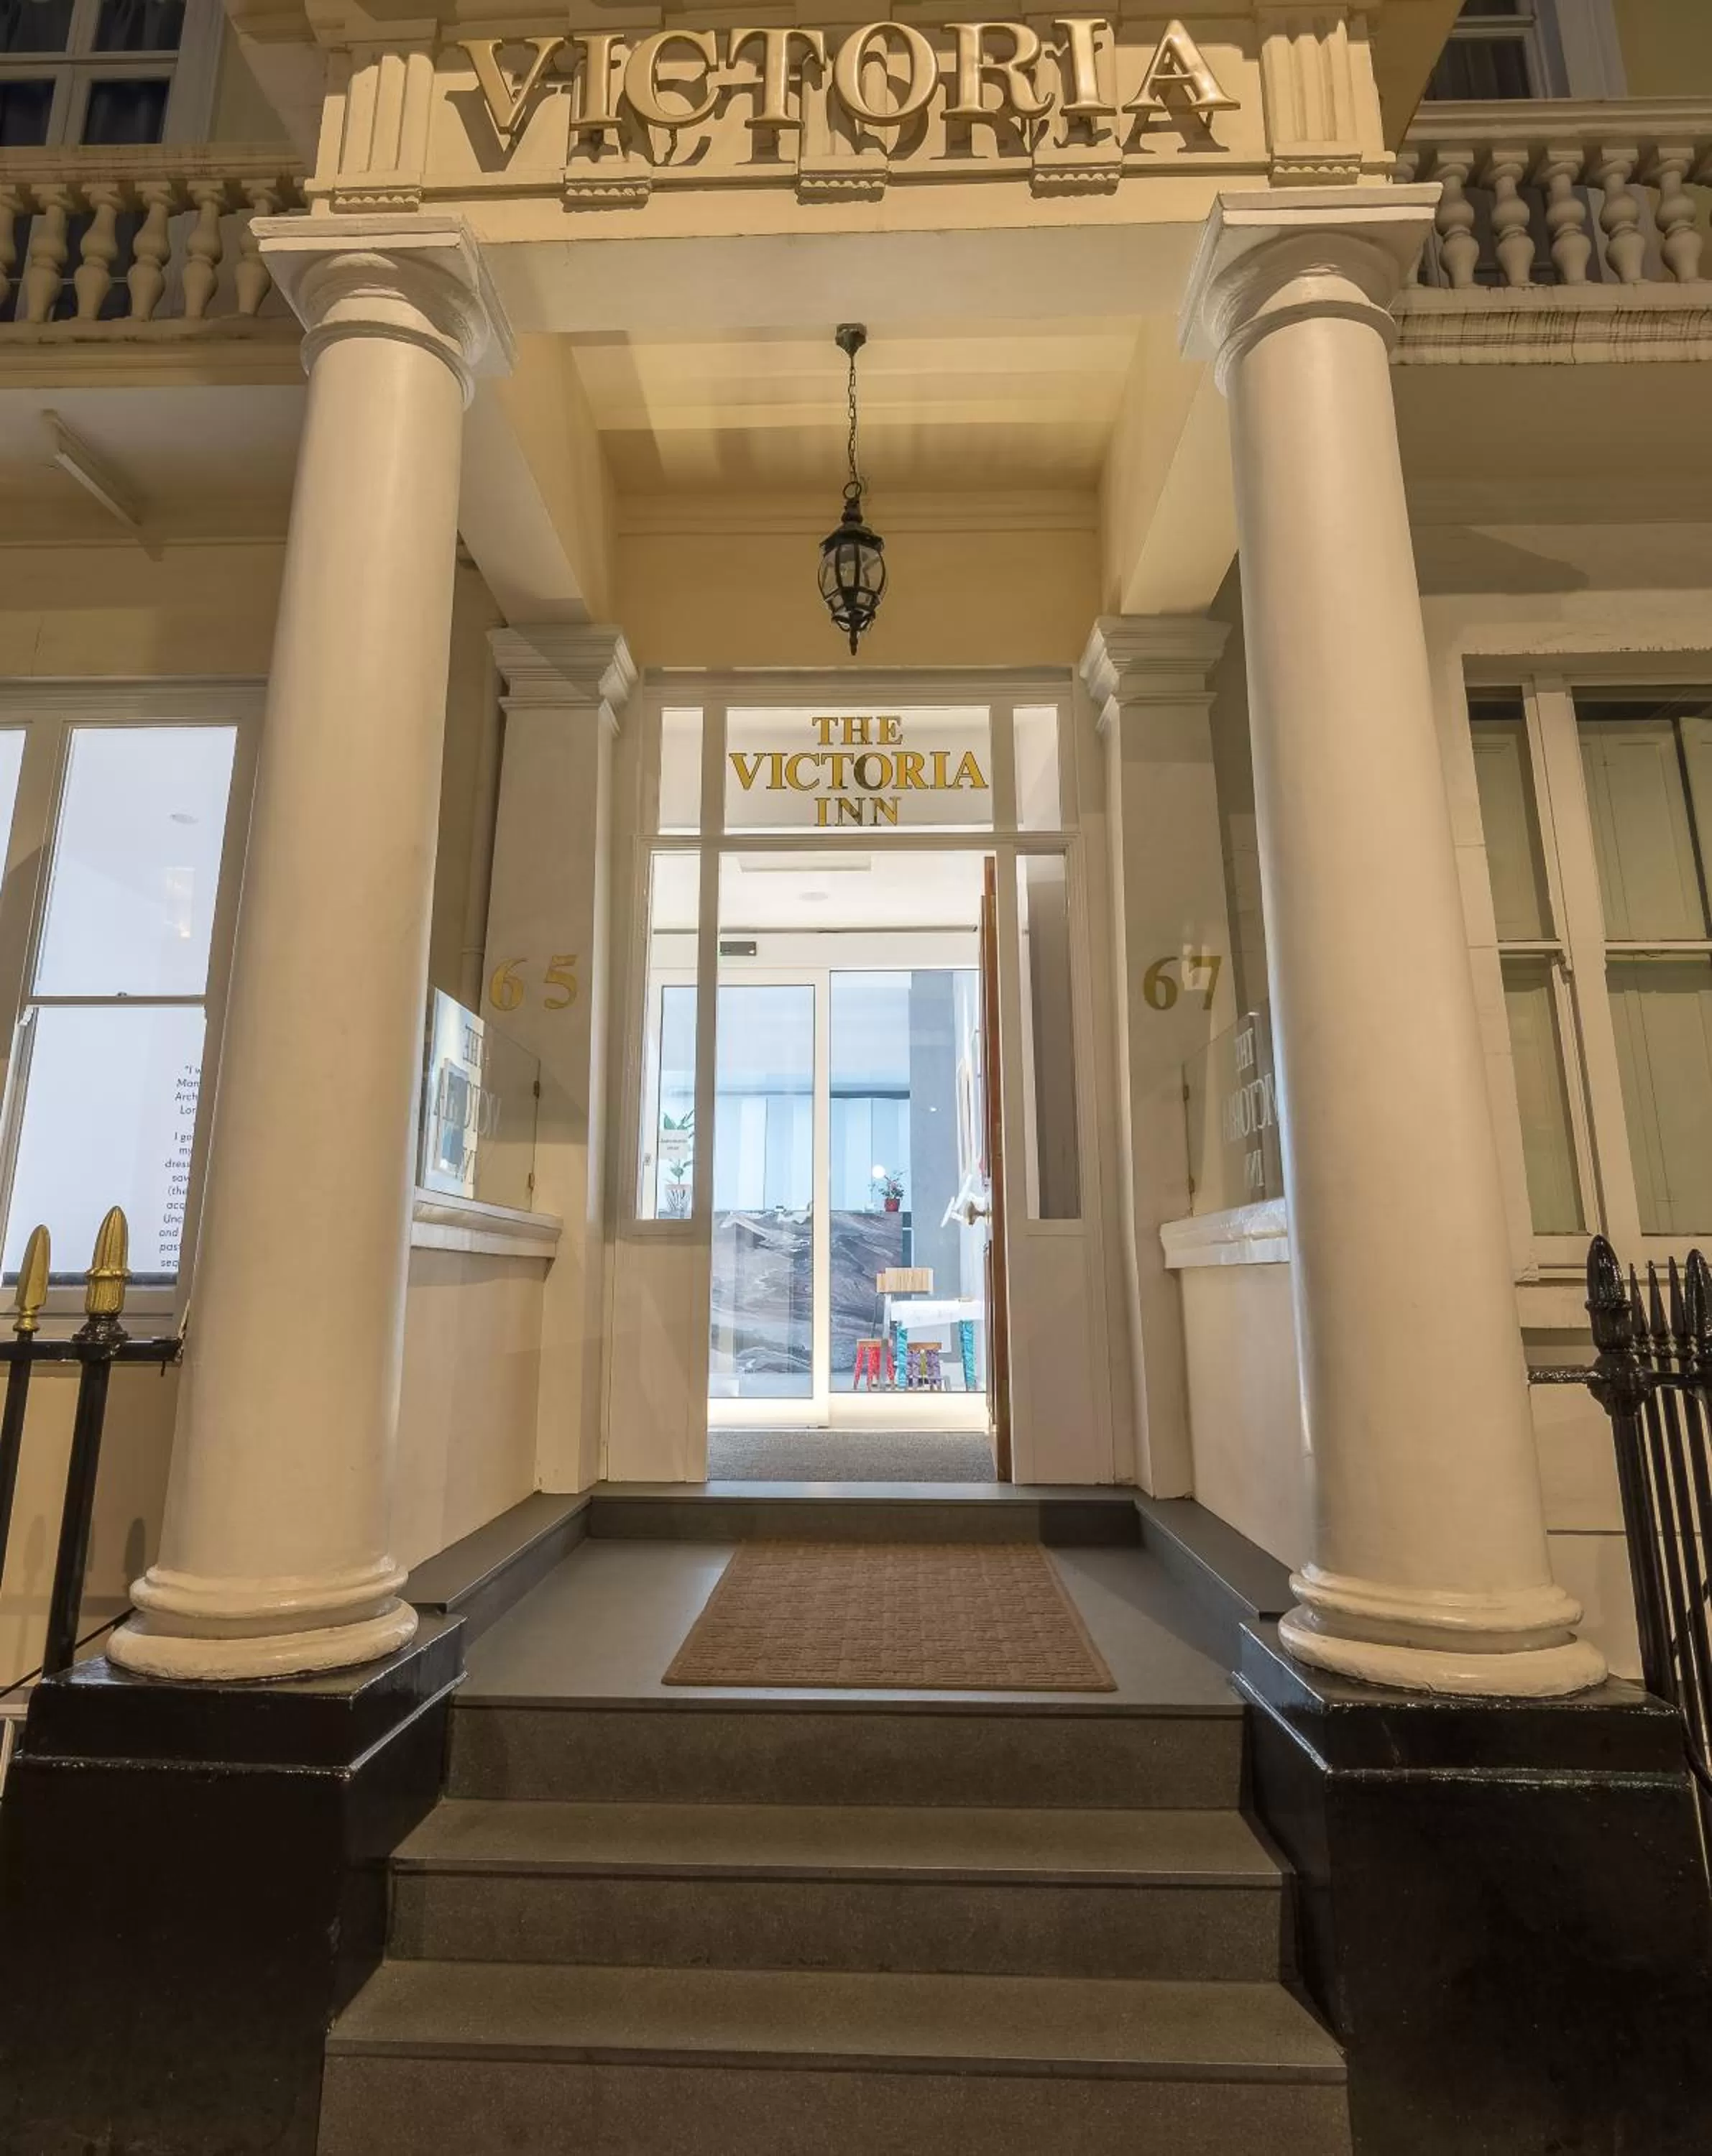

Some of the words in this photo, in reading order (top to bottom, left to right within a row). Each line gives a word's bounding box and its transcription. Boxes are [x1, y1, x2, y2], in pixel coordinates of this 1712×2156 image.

[456, 19, 1242, 133] VICTORIA
[811, 715, 903, 745] THE
[728, 750, 990, 791] VICTORIA
[814, 796, 902, 827] INN
[488, 954, 578, 1011] 65
[1143, 954, 1222, 1011] 67
